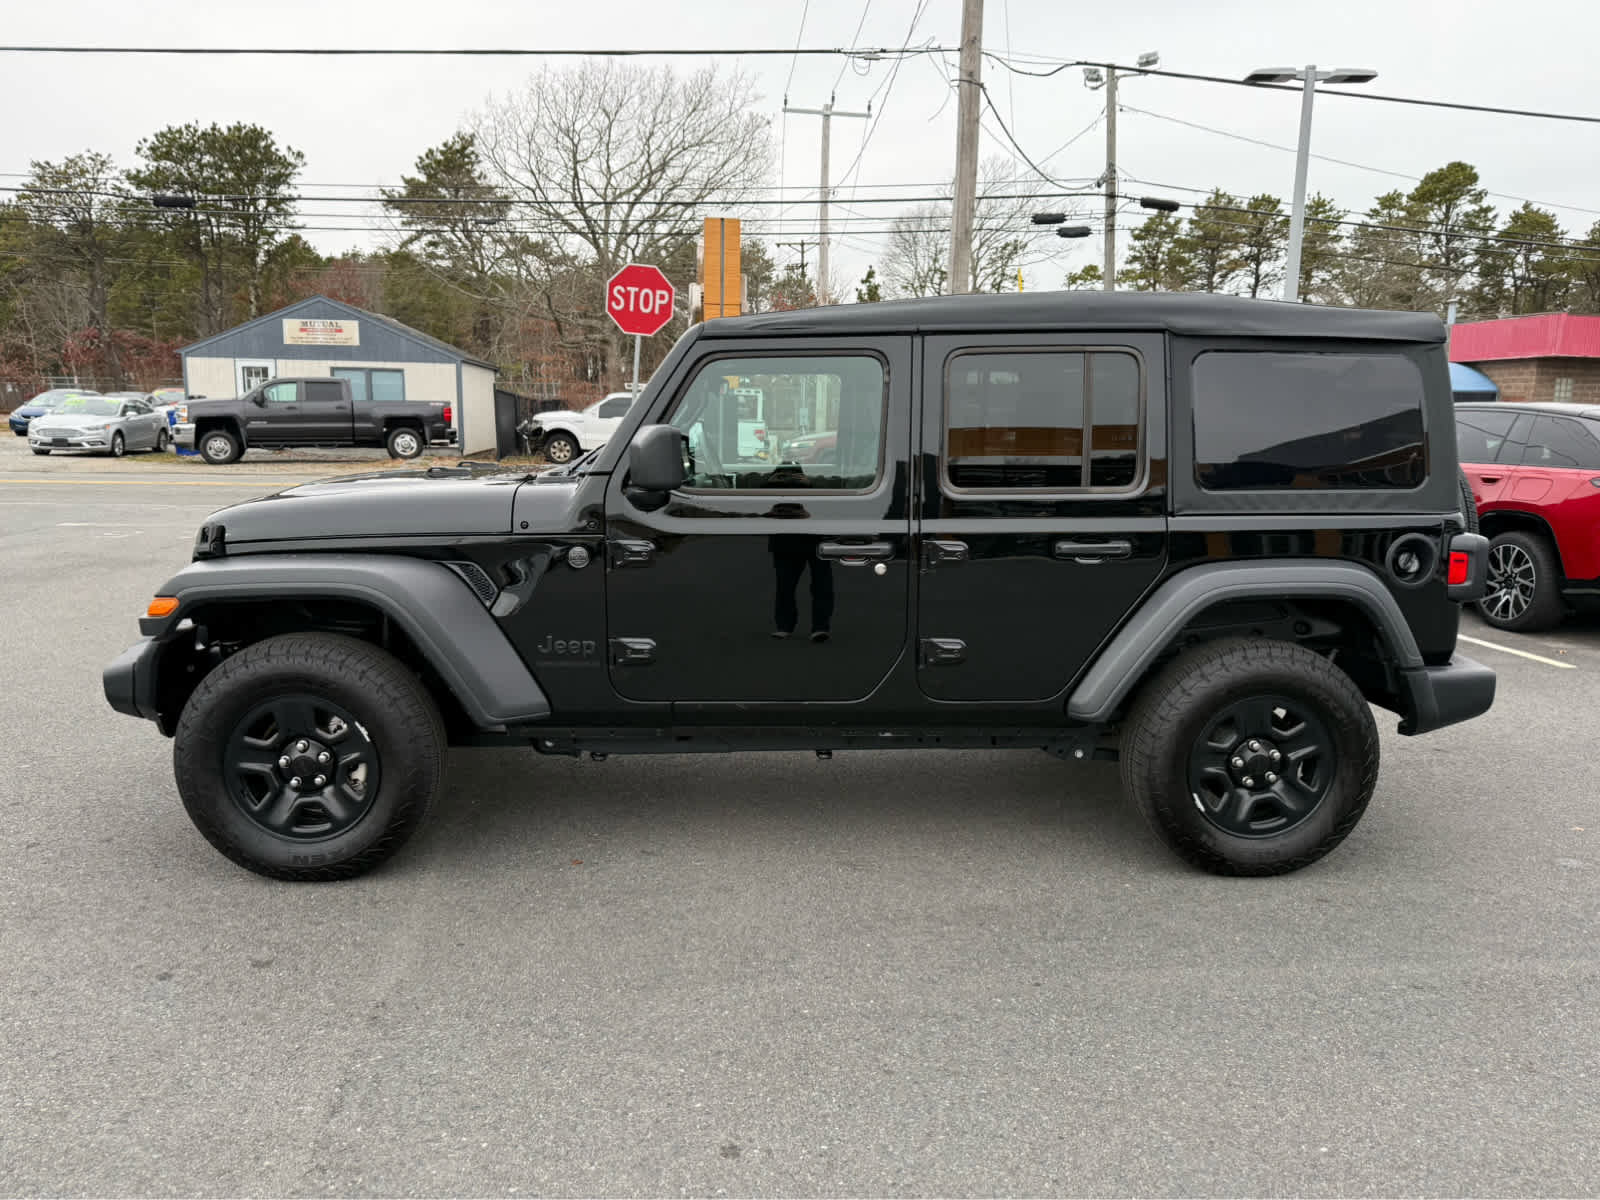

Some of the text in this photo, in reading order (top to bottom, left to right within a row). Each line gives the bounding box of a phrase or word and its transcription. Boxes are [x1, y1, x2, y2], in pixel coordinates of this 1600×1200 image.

[611, 285, 670, 315] STOP
[300, 320, 342, 328] MUTUAL
[537, 635, 596, 659] Jeep
